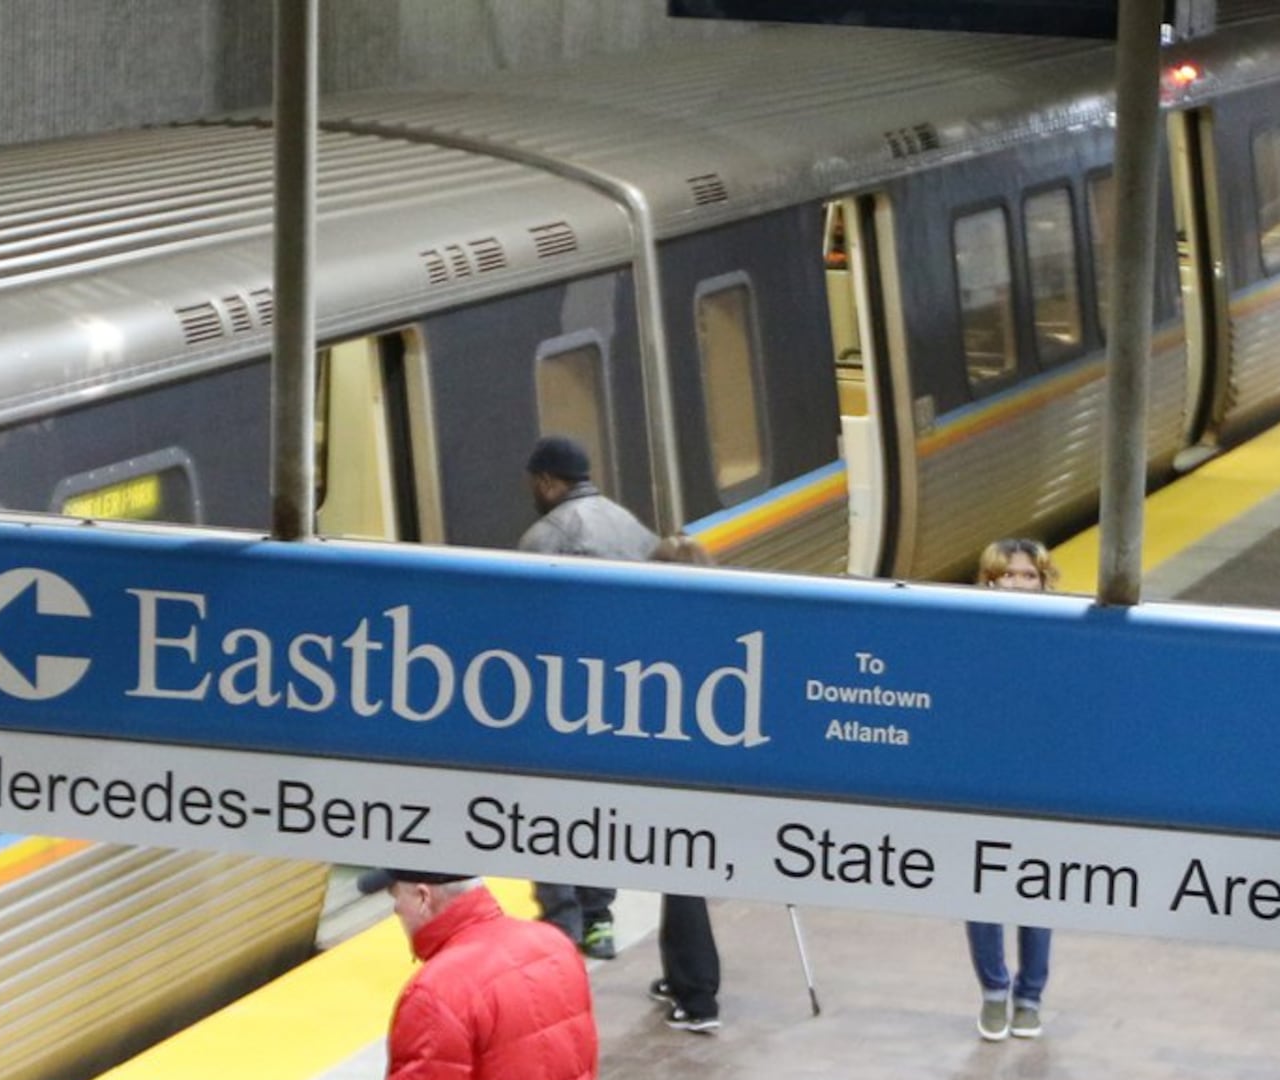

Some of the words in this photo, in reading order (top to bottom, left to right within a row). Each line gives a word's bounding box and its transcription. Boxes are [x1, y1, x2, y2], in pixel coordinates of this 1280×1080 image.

[125, 588, 770, 747] Eastbound
[855, 652, 885, 675] To
[806, 679, 931, 709] Downtown
[825, 719, 909, 745] Atlanta
[465, 796, 734, 881] Stadium,
[774, 823, 935, 889] State
[973, 840, 1138, 908] Farm
